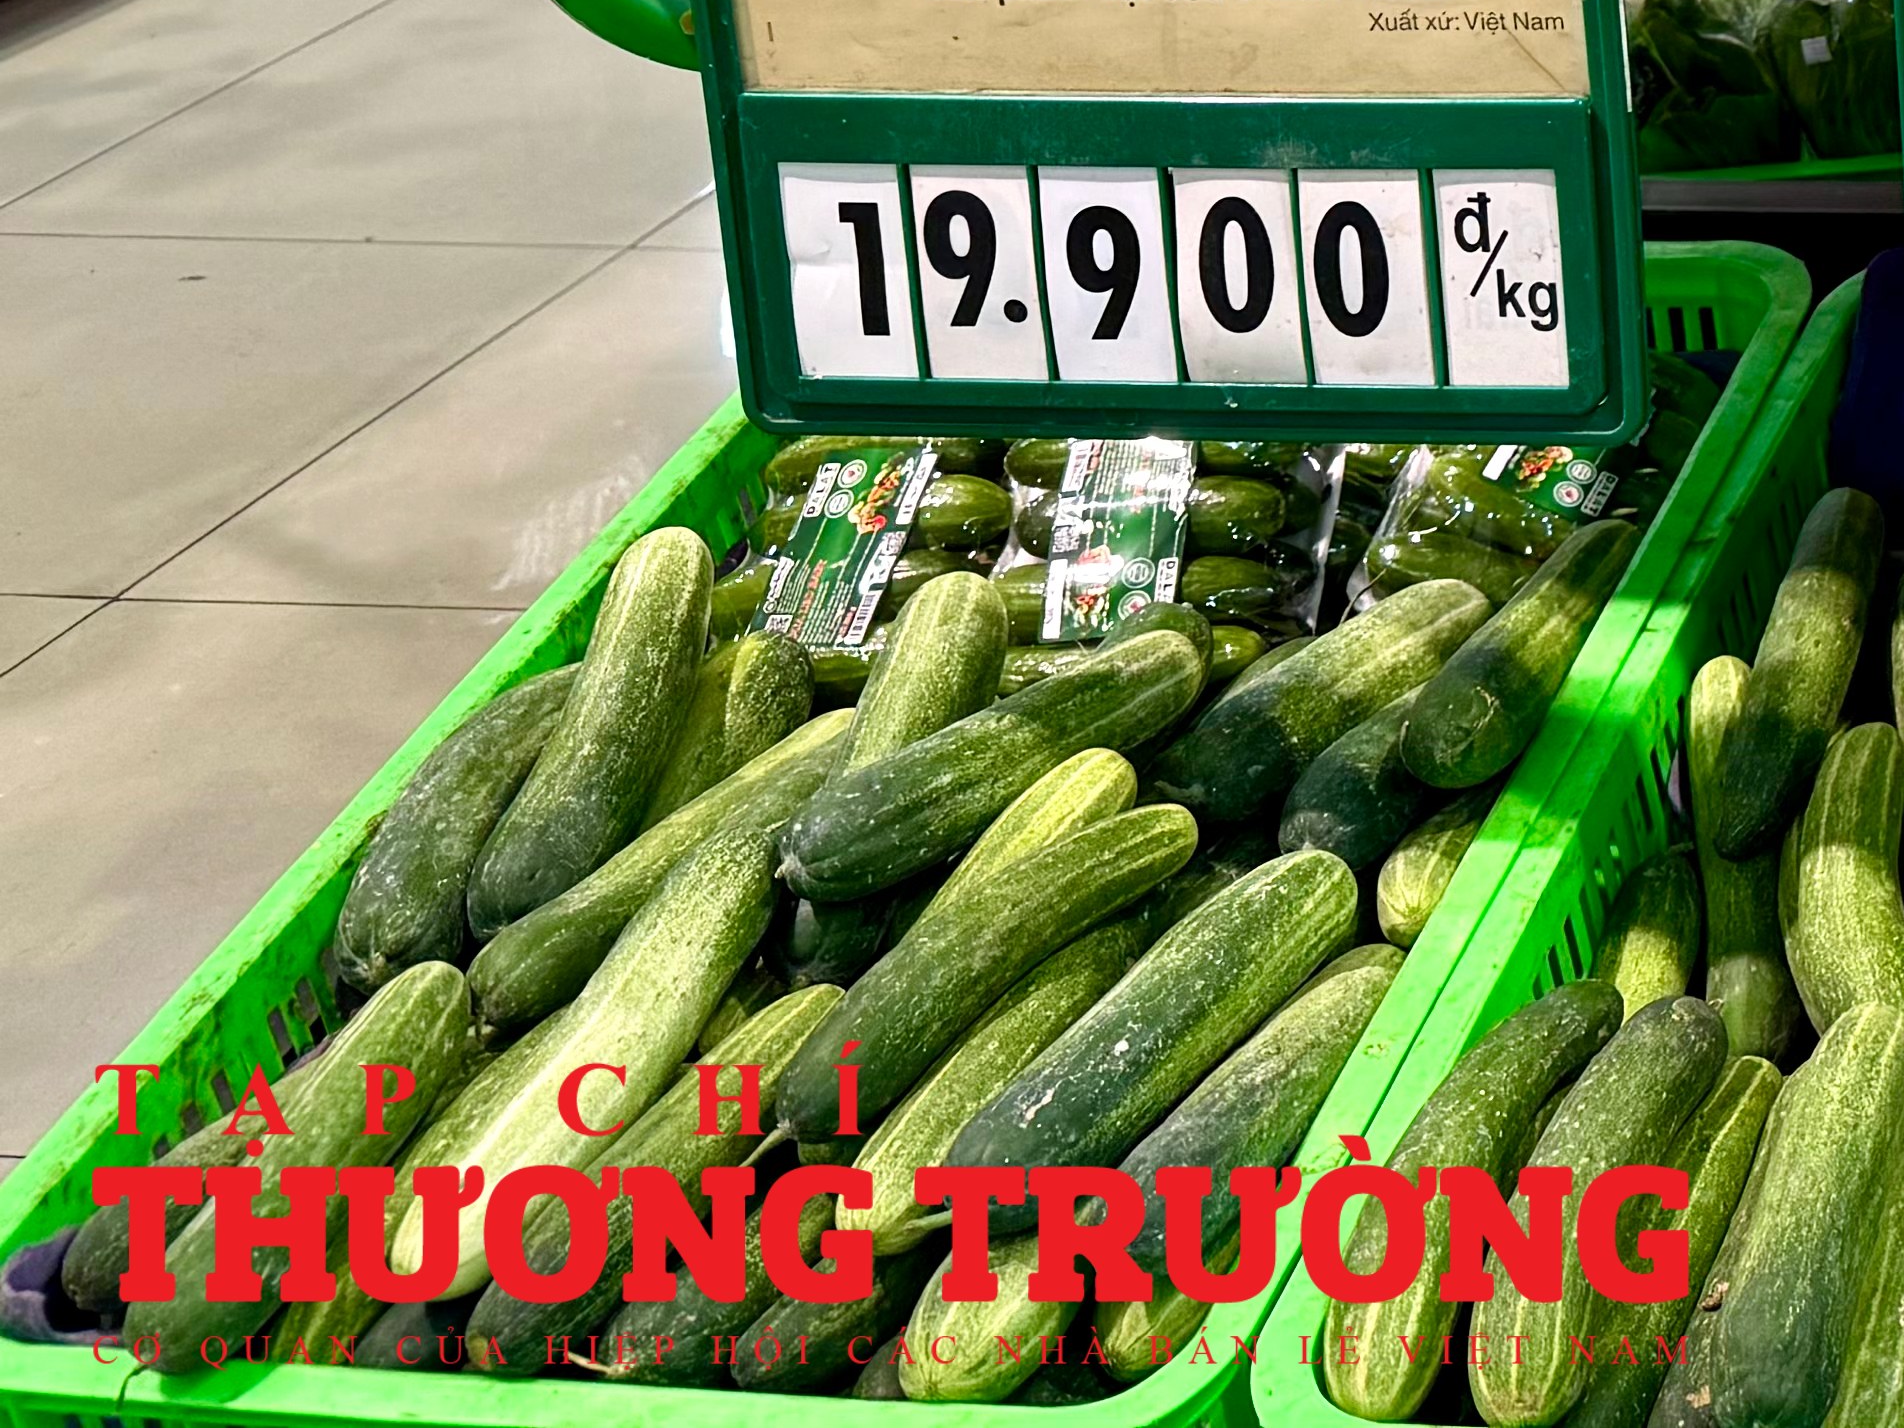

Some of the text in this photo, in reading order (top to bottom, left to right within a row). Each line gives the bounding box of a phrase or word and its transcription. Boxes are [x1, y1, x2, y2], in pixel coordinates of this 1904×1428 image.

[1368, 8, 1566, 36] Xuất xứ: Việt Nam
[838, 188, 1390, 341] 19.900
